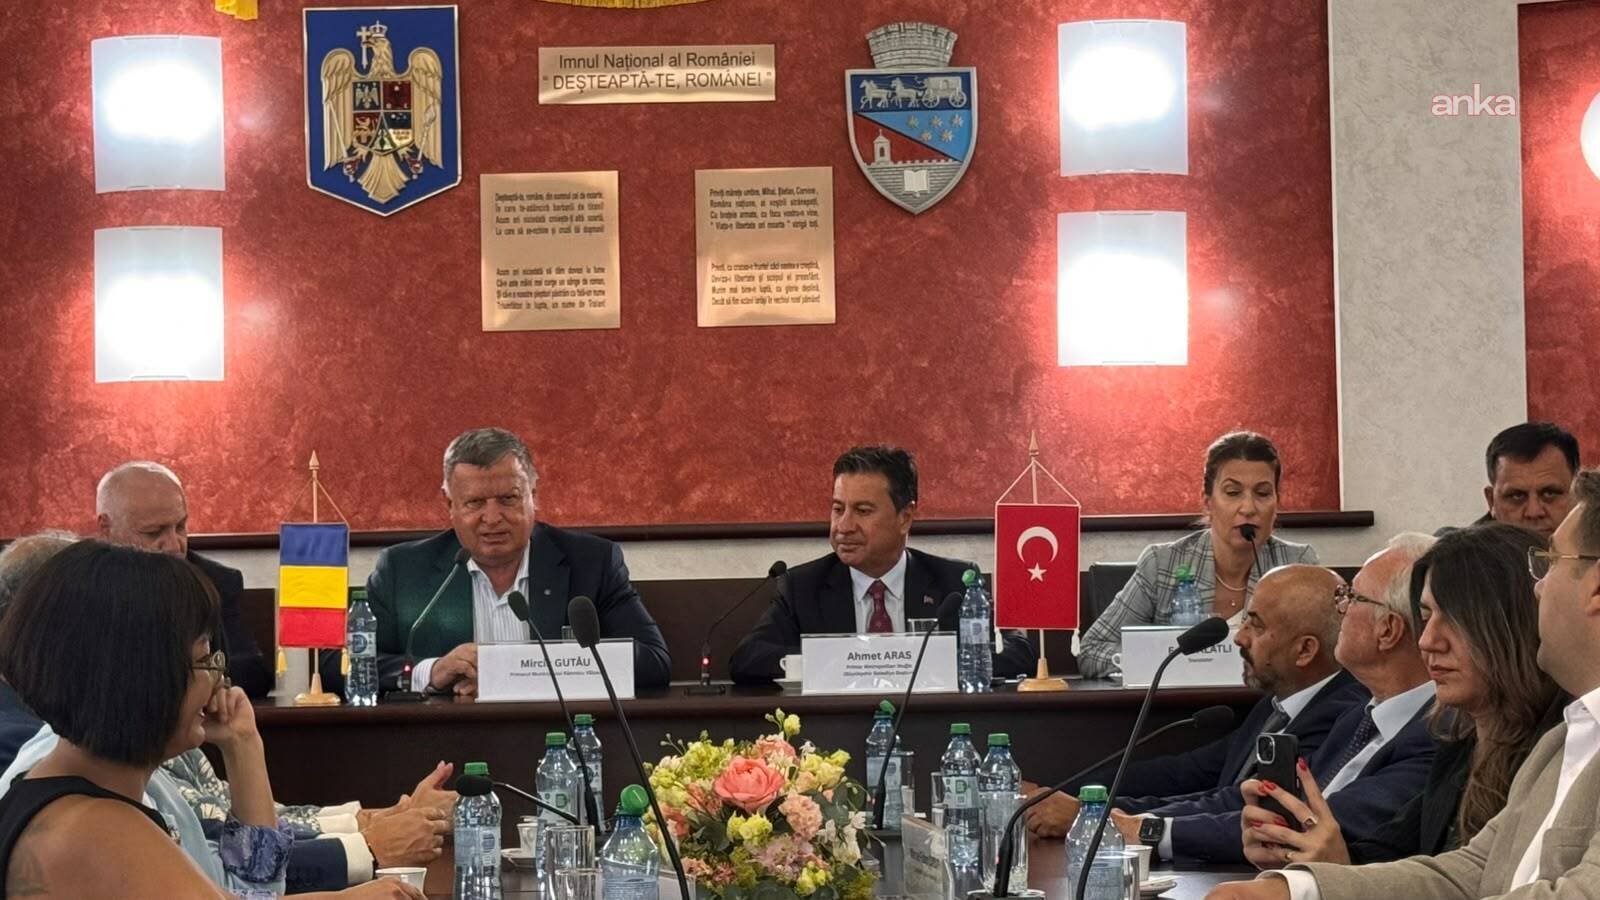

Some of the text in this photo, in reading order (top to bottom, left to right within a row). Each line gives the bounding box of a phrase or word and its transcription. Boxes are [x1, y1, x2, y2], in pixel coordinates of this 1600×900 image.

[559, 54, 599, 69] Imnul
[669, 53, 681, 67] al
[687, 51, 756, 67] României
[848, 650, 912, 660] Ahmet ARAS
[520, 658, 551, 668] Mirci
